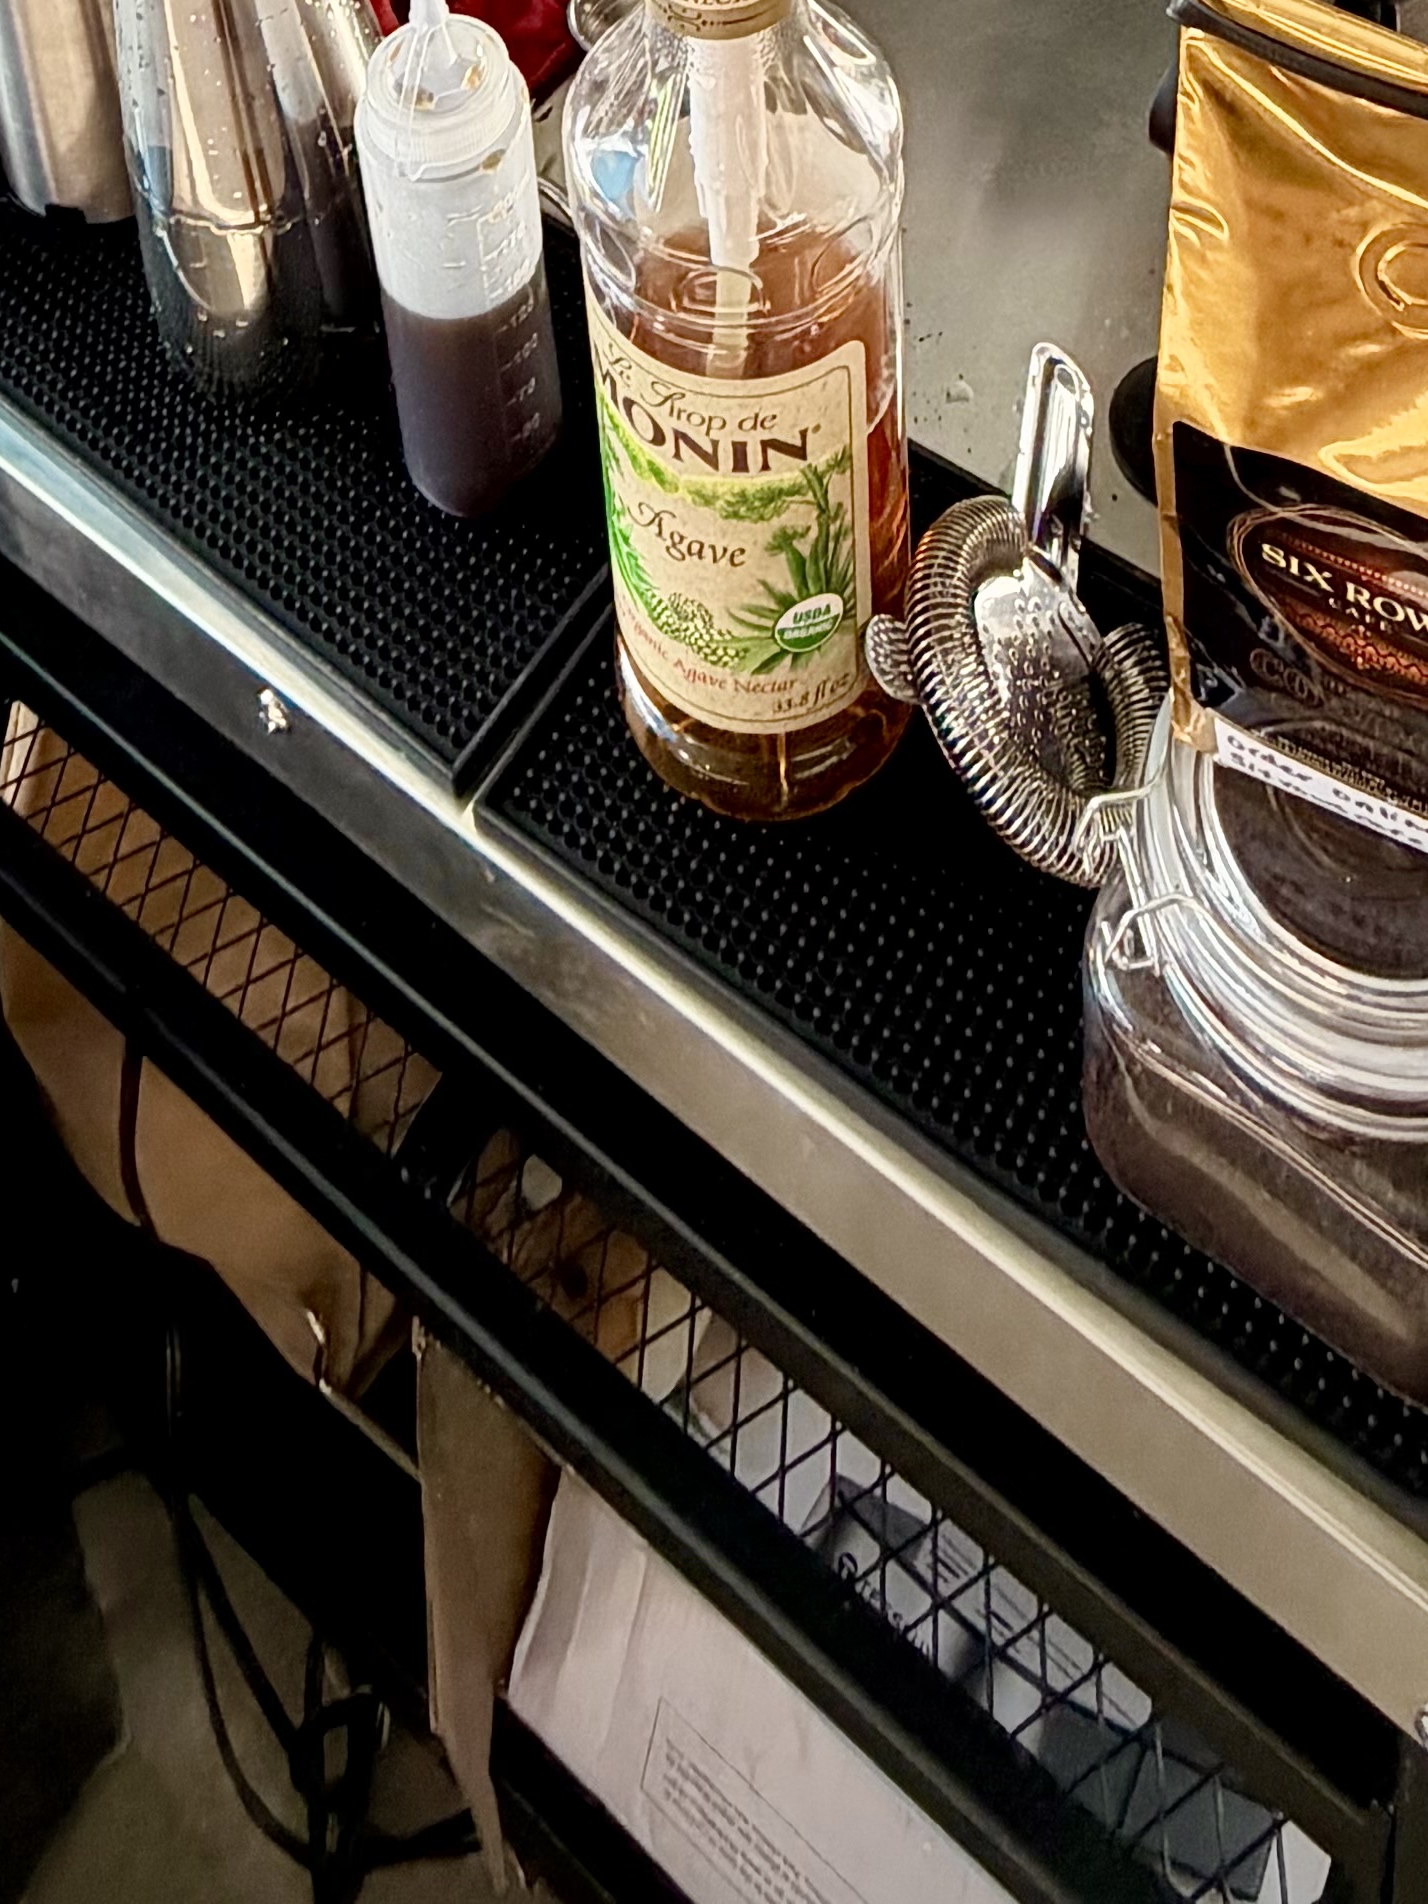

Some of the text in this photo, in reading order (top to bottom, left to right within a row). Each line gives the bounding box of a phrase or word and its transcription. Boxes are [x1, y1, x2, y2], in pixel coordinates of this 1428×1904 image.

[593, 342, 811, 474] MONIN
[640, 381, 727, 437] Sirop
[738, 407, 778, 432] de
[627, 501, 747, 567] Agave
[1261, 543, 1335, 593] SIX
[793, 603, 832, 624] USDA
[673, 653, 727, 690] Agave
[732, 677, 797, 695] Nectar
